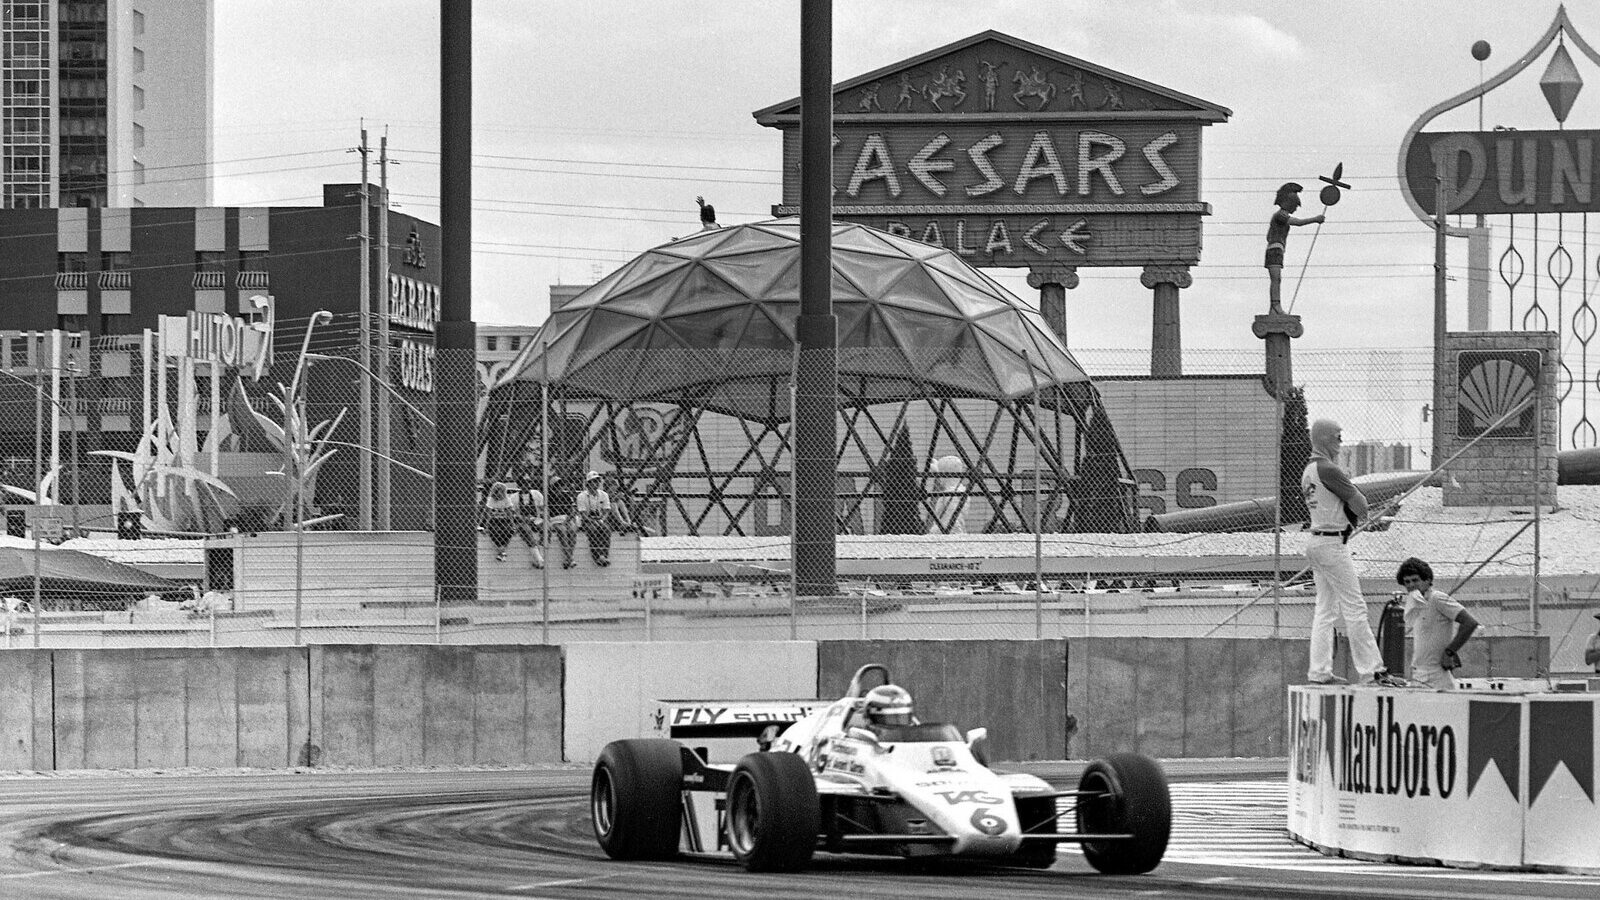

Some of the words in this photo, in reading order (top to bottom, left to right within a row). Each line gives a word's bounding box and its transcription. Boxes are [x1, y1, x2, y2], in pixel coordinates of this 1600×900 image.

[832, 130, 1182, 197] AESARS
[1430, 134, 1593, 212] DUN
[673, 707, 728, 725] FLY
[1339, 694, 1457, 799] Marlboro
[933, 790, 1005, 805] TAG
[970, 808, 1008, 836] 6
